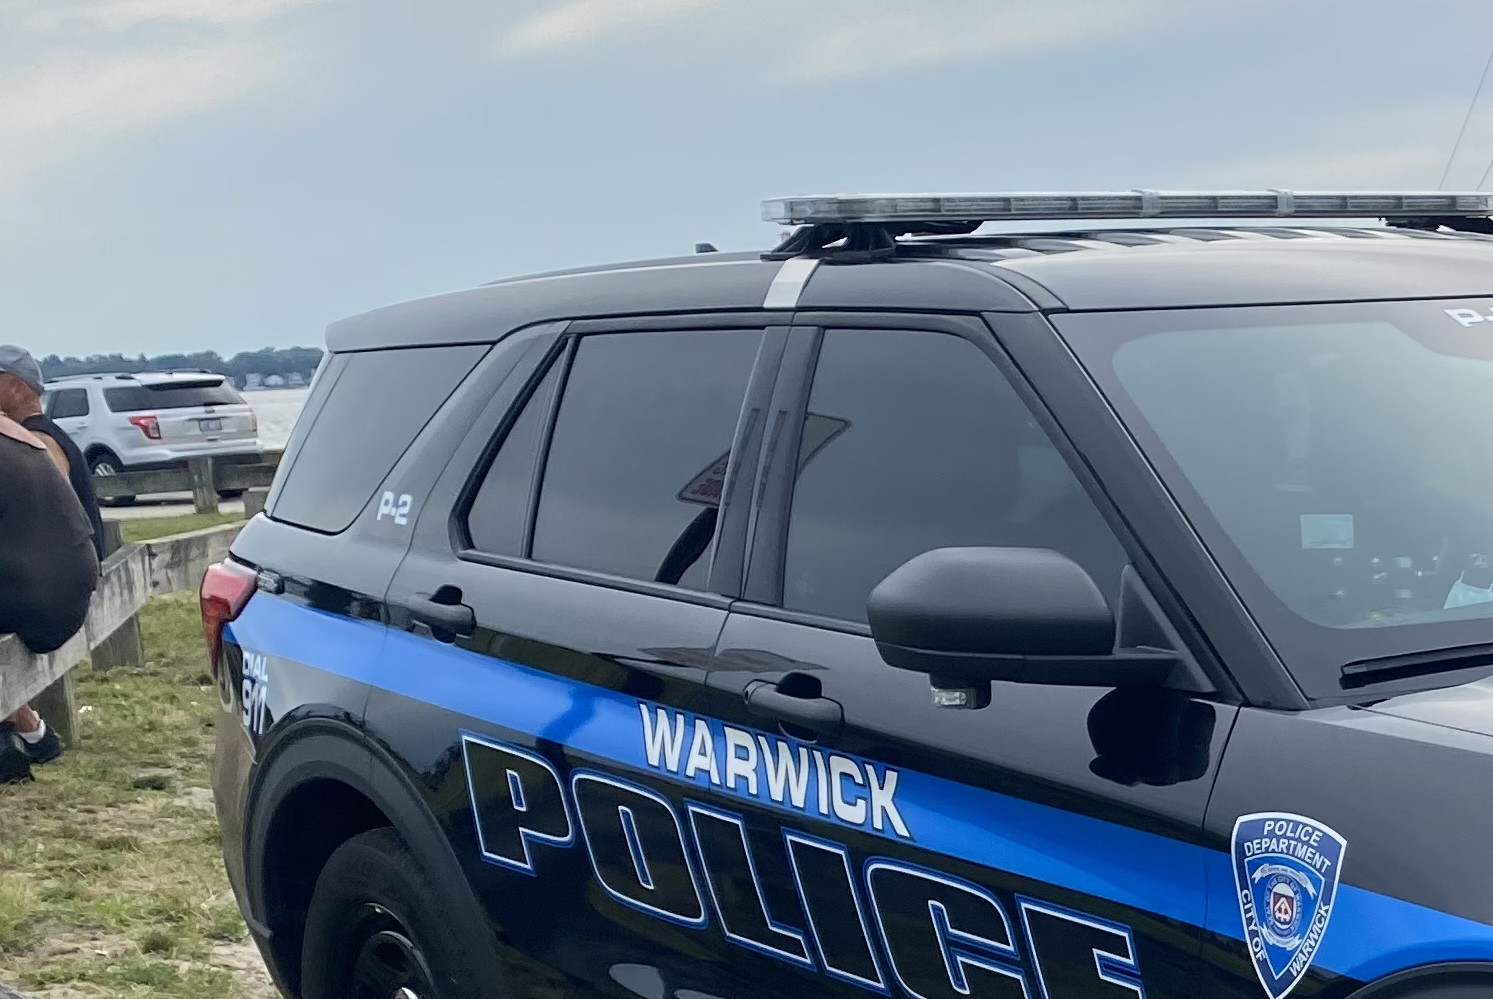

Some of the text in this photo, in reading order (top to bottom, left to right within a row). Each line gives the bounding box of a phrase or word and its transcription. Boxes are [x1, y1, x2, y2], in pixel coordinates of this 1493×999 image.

[376, 491, 413, 525] P-2
[242, 650, 268, 683] DIAL
[242, 678, 267, 735] 911
[637, 702, 913, 839] WARWICK
[1263, 820, 1323, 847] POLICE
[1244, 838, 1331, 873] DEPARTMENT
[1240, 889, 1259, 933] CITY
[1250, 937, 1267, 962] OF
[1289, 903, 1330, 977] WARWICK
